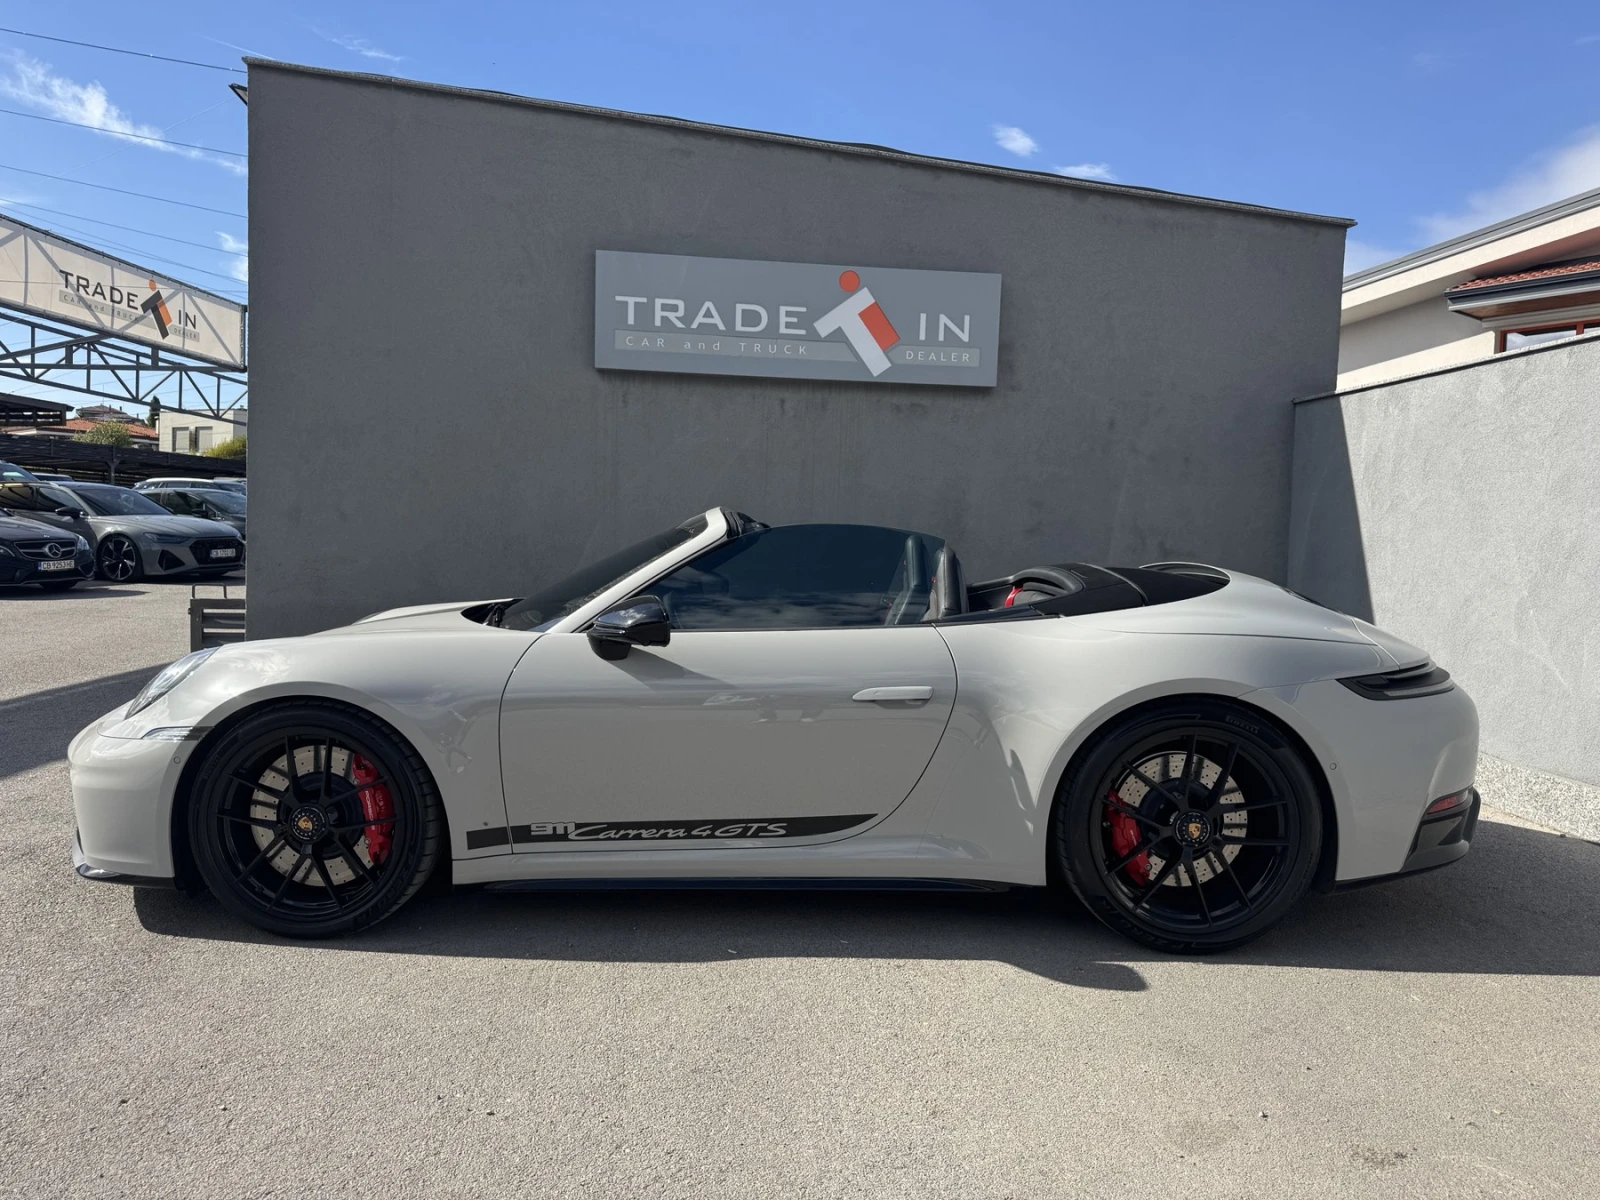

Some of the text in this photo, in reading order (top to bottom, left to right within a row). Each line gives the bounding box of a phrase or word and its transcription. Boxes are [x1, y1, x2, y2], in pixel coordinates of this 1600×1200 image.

[59, 269, 139, 311] TRADE
[178, 309, 197, 330] IN
[615, 295, 808, 336] TRADE
[918, 312, 971, 343] IN
[625, 335, 971, 363] CAR and TRUCK DEALER
[530, 822, 788, 840] 911 Carrera 4 GTS
